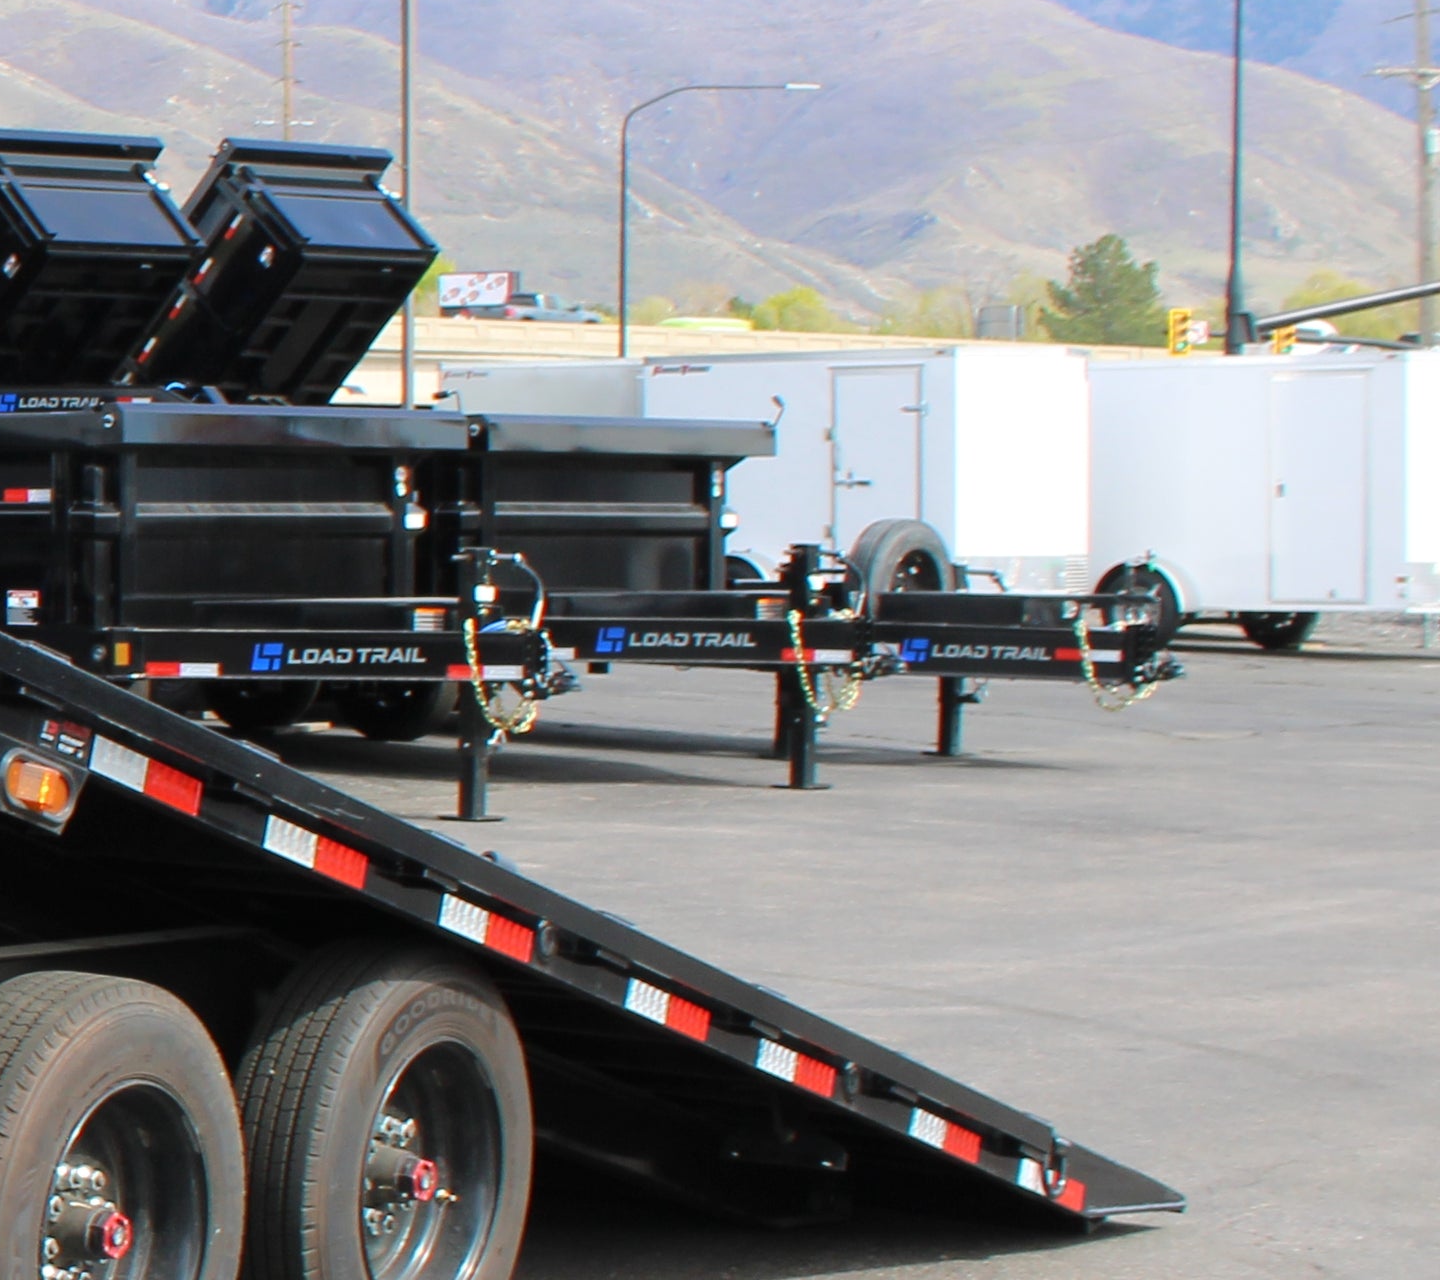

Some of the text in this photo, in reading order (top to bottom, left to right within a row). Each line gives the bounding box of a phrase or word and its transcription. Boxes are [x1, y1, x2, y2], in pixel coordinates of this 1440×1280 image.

[19, 397, 60, 408] LOAD
[629, 632, 757, 648] LOAD TRAIL
[287, 647, 428, 664] LOAD TRAIL
[931, 643, 1053, 661] LOAD TRAIL
